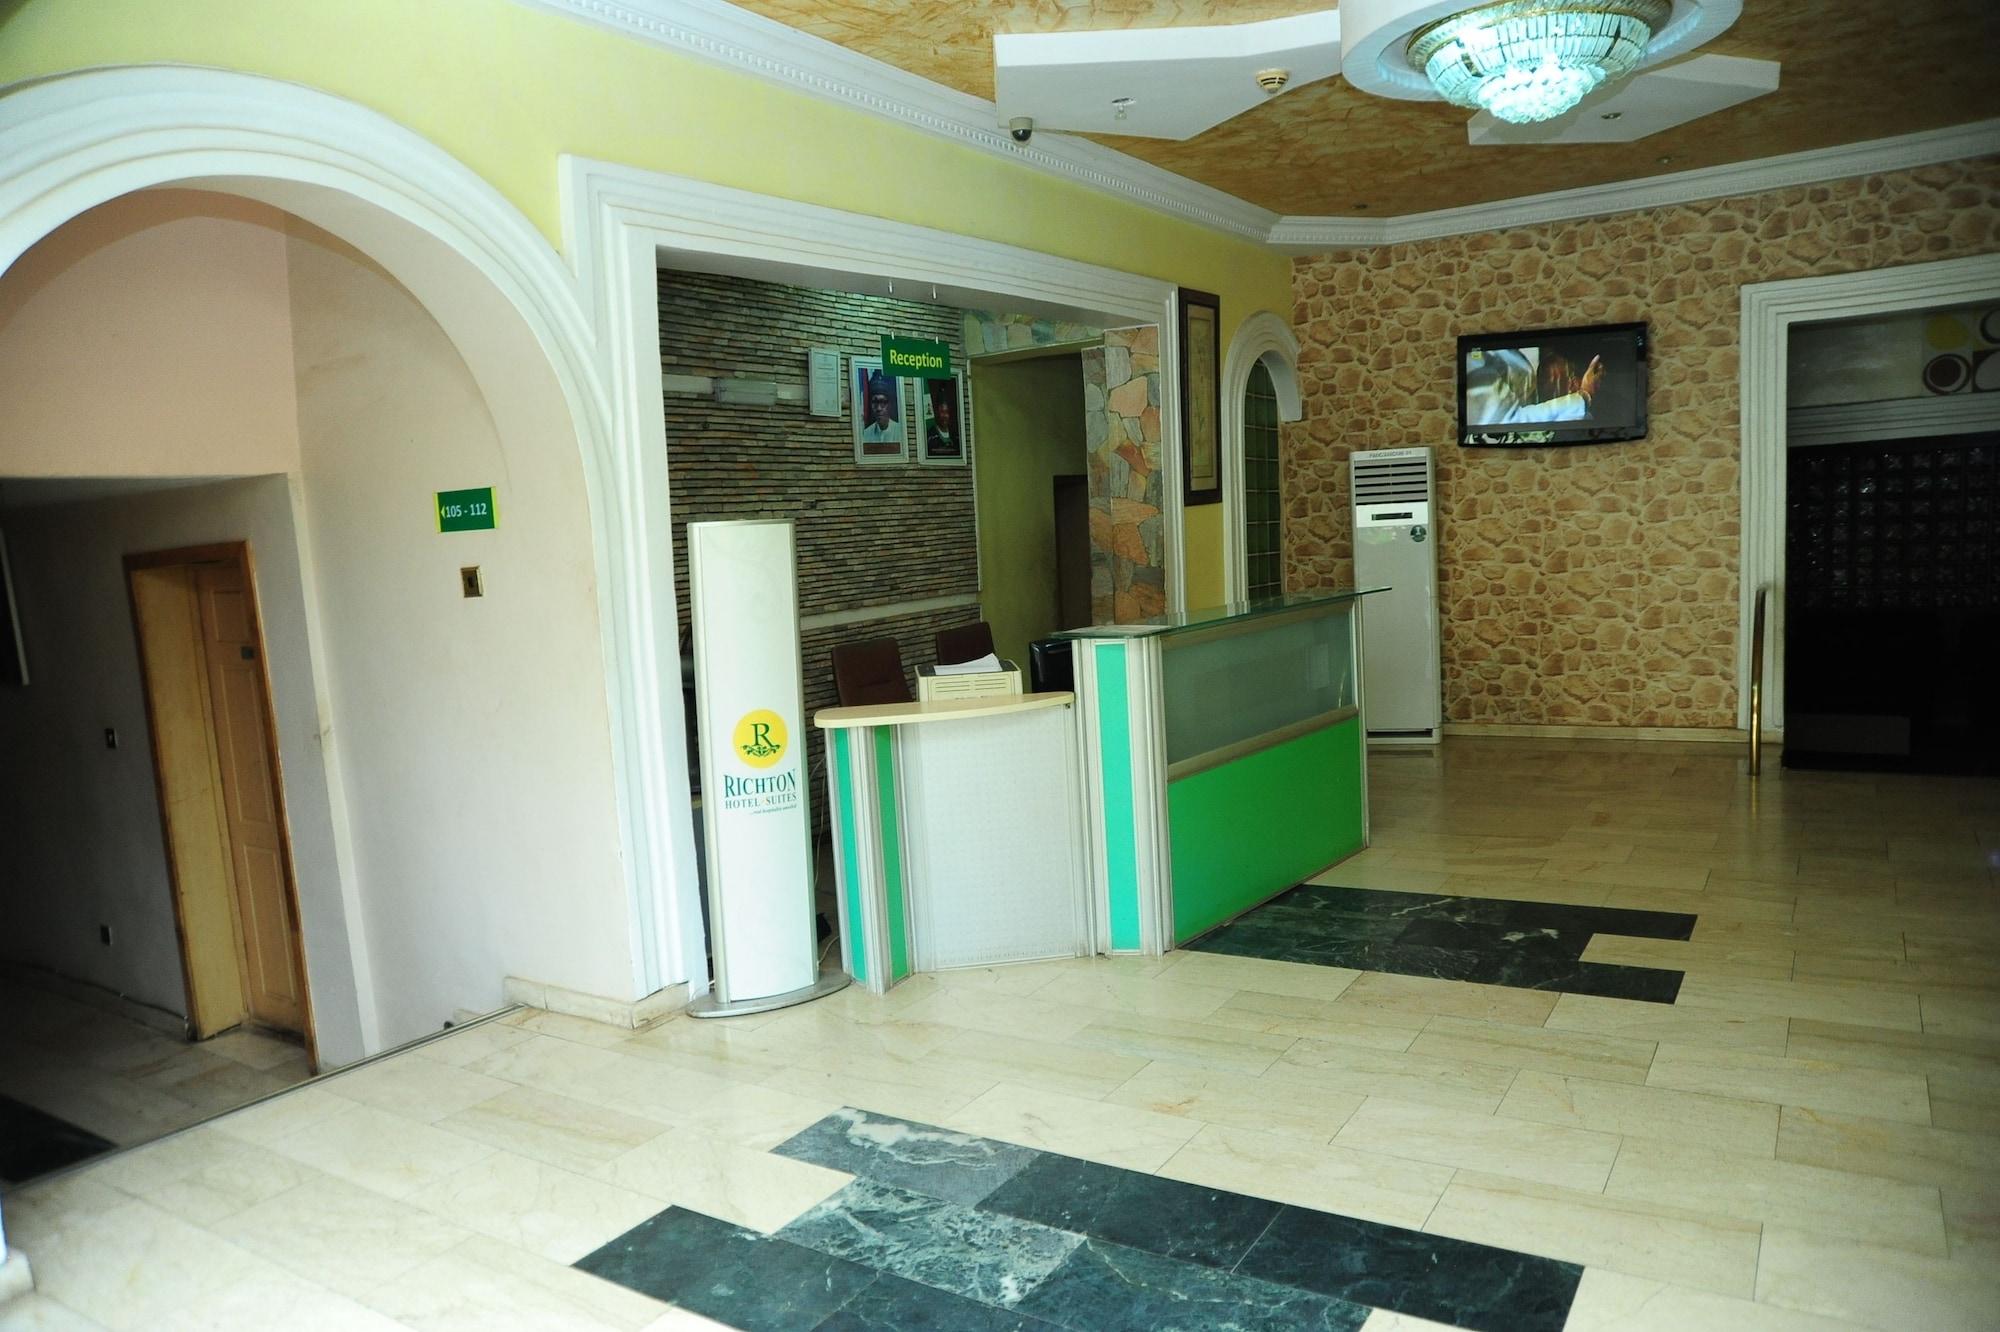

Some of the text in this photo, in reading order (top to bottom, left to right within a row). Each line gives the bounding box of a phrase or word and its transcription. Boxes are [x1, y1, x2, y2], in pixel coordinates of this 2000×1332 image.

[889, 349, 943, 370] Reception
[446, 505, 462, 517] 105
[470, 503, 487, 516] 112
[751, 722, 777, 748] R
[723, 768, 796, 798] RICHTON
[725, 793, 797, 809] HOTEL SUITES
